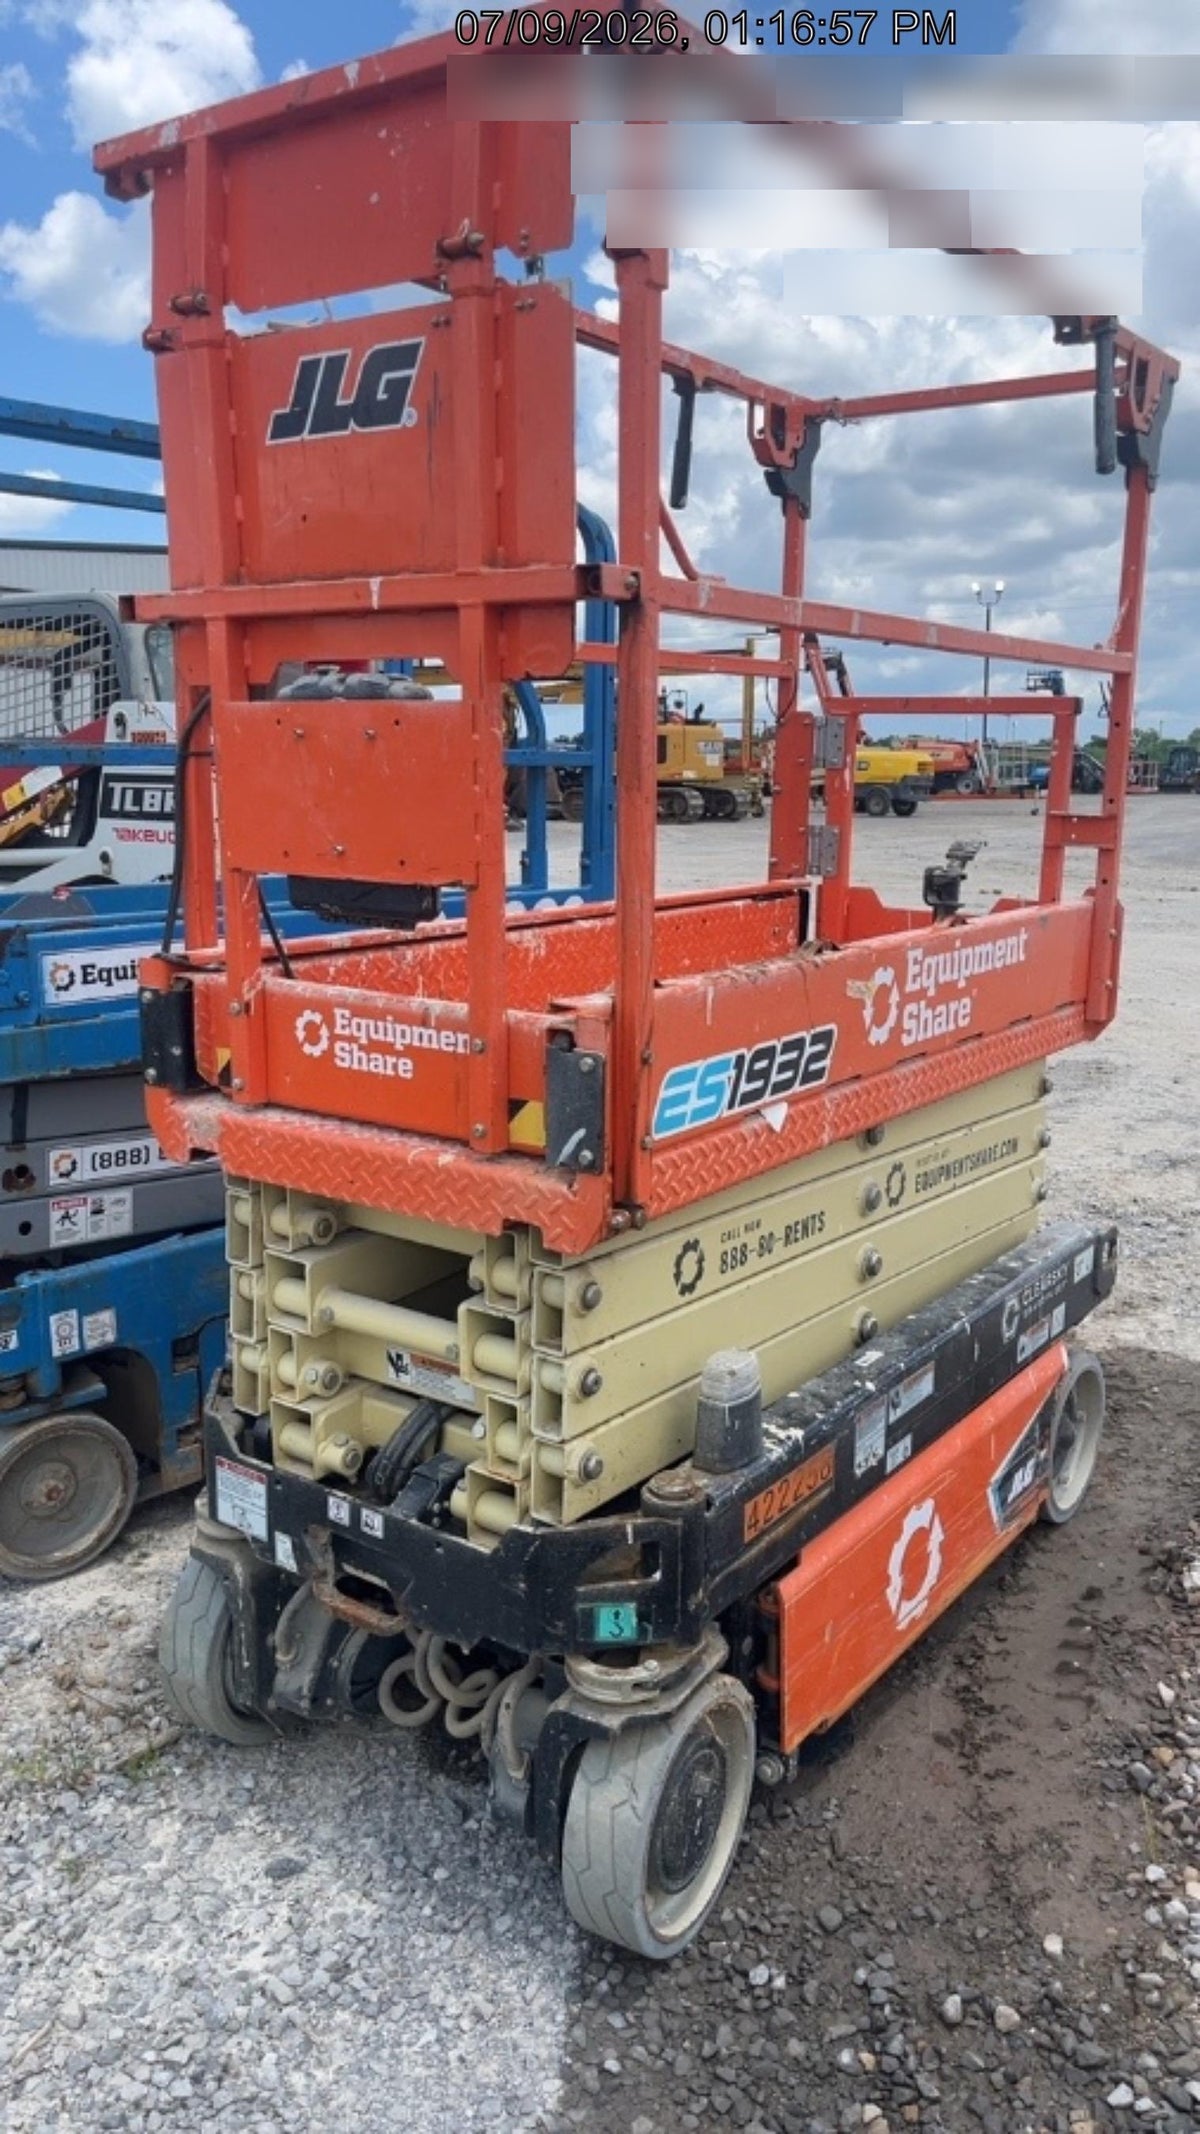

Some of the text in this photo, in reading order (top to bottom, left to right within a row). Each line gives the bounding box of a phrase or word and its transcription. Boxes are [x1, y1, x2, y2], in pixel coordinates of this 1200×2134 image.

[265, 337, 425, 446] JLG
[905, 927, 1029, 997] Equipment
[333, 1007, 471, 1055] Equipmen
[901, 997, 972, 1047] Share
[333, 1040, 414, 1079] Share
[653, 1022, 838, 1141] ES1932
[91, 1145, 150, 1172] (888)
